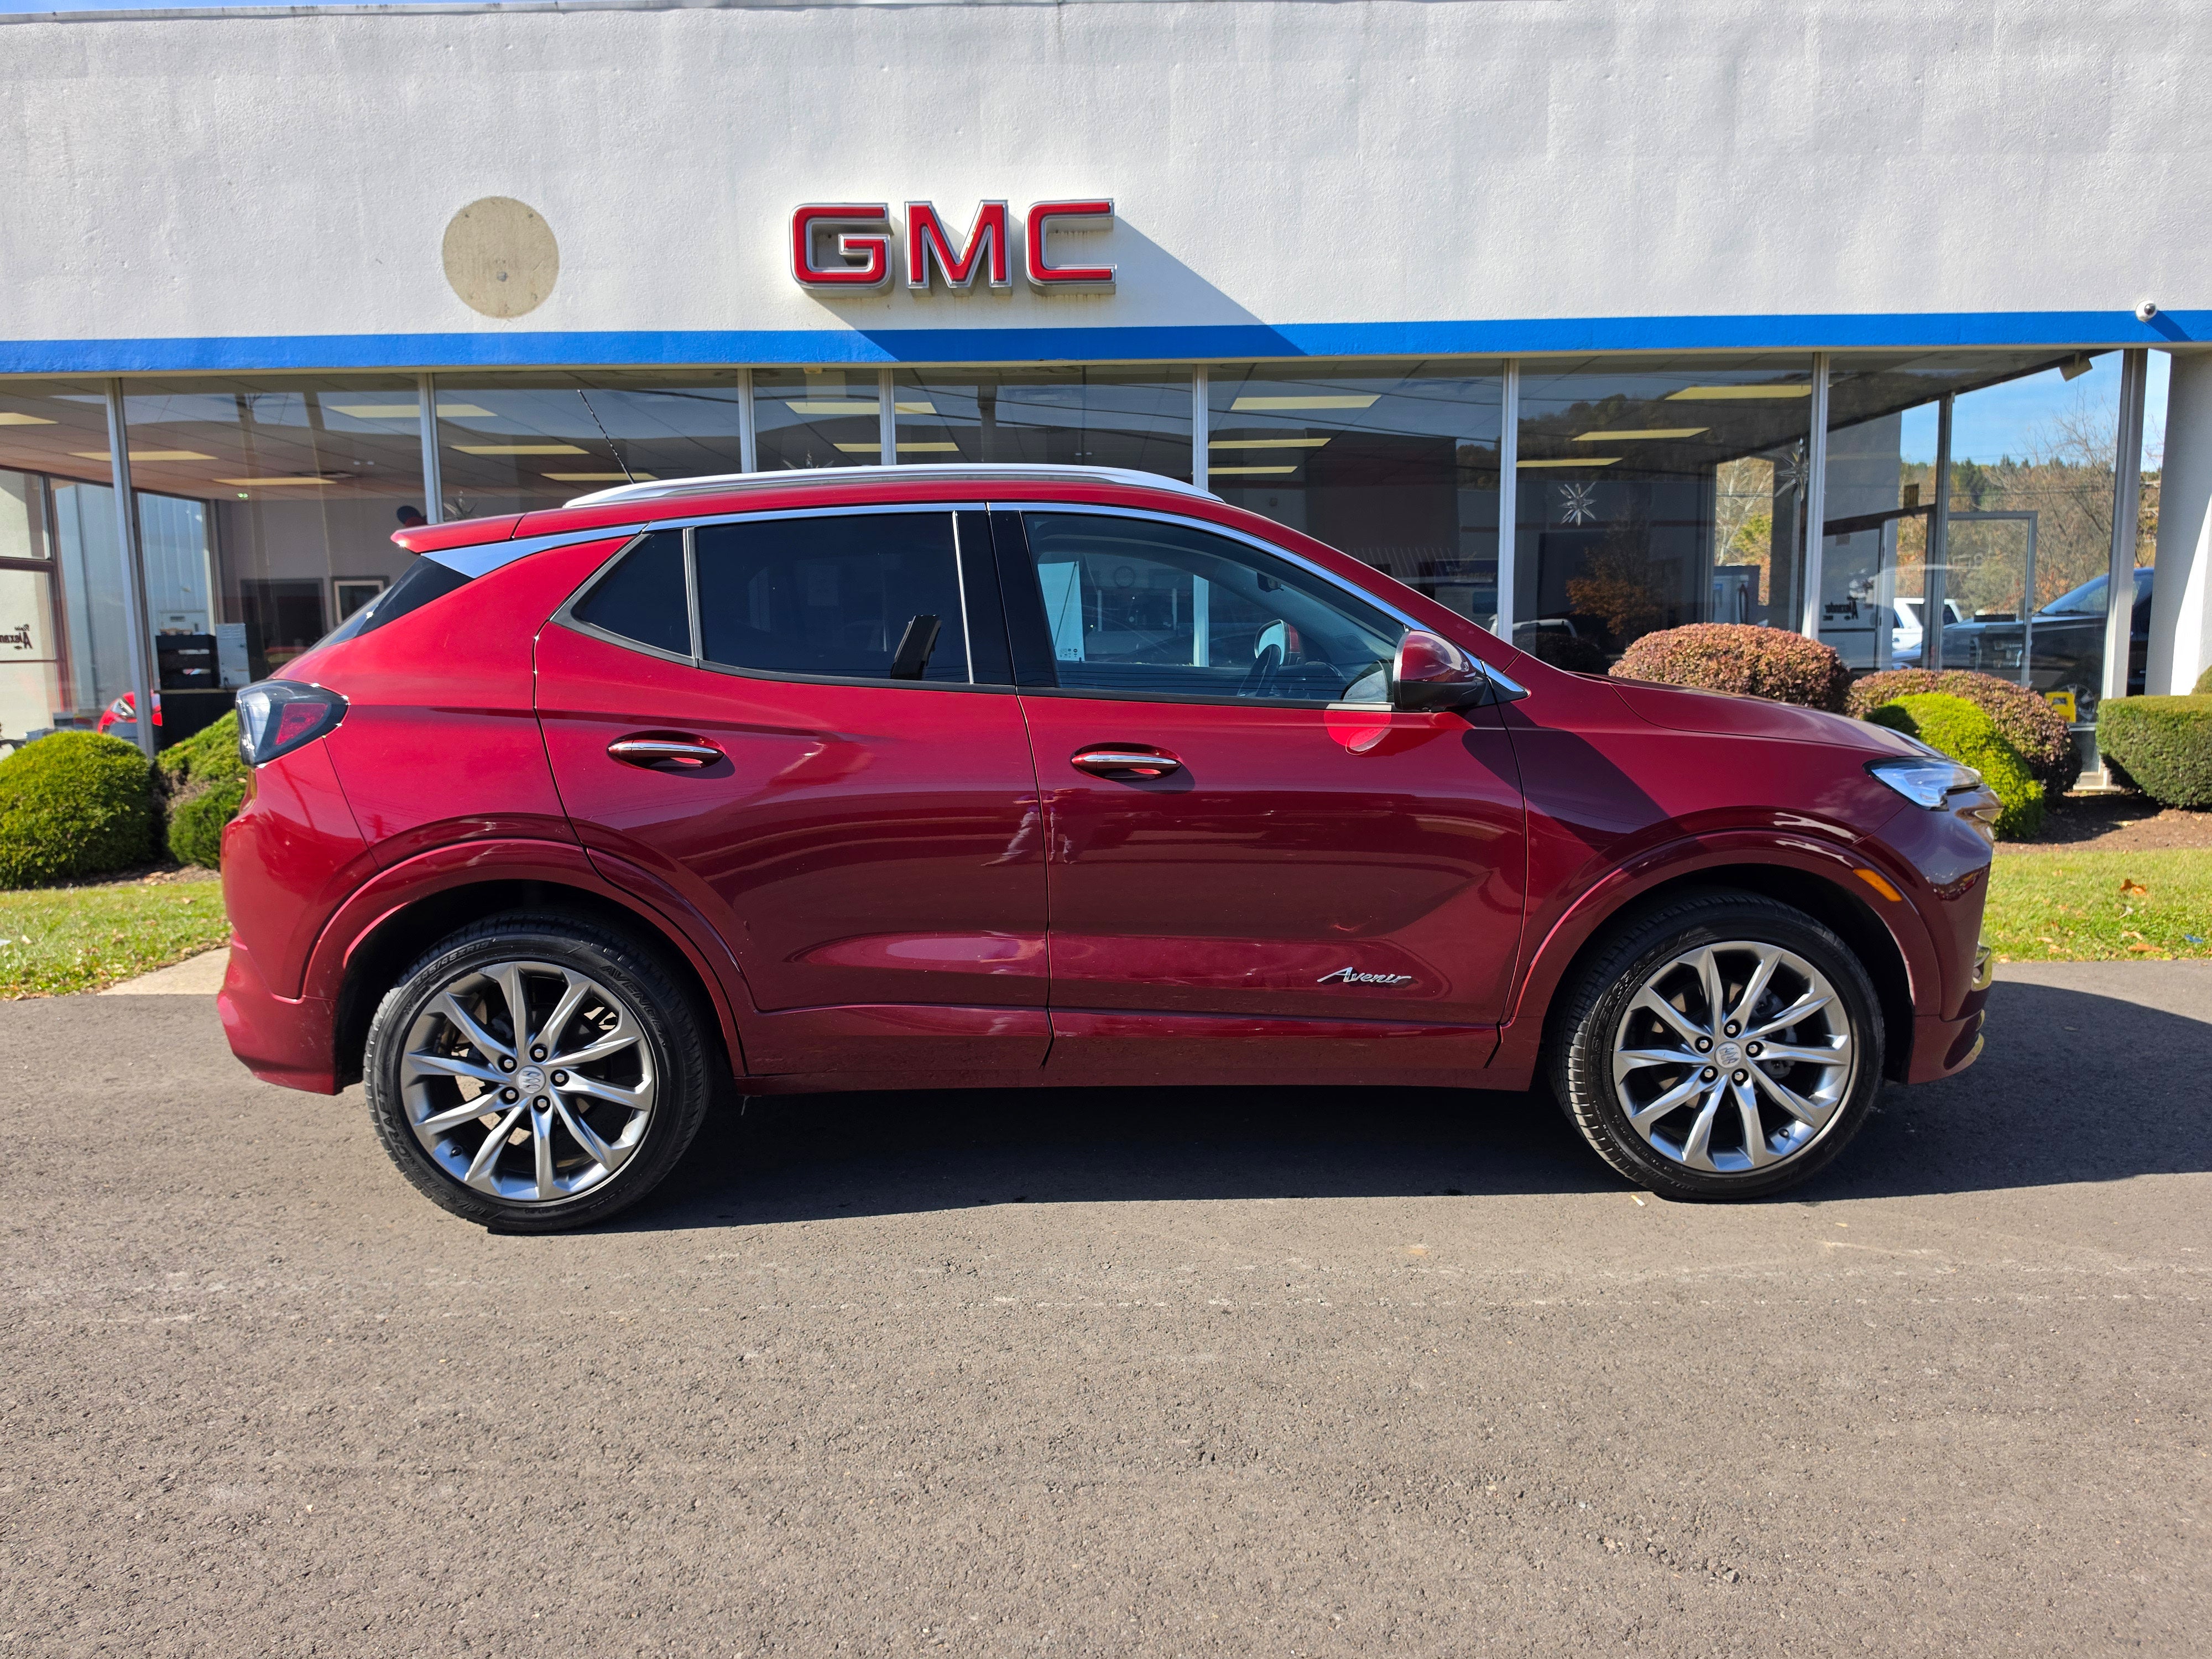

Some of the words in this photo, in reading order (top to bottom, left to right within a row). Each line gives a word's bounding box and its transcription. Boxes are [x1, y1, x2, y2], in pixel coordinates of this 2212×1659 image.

[789, 199, 1117, 291] GMC
[599, 965, 668, 1047] AVENGER
[1317, 966, 1412, 984] Avenir
